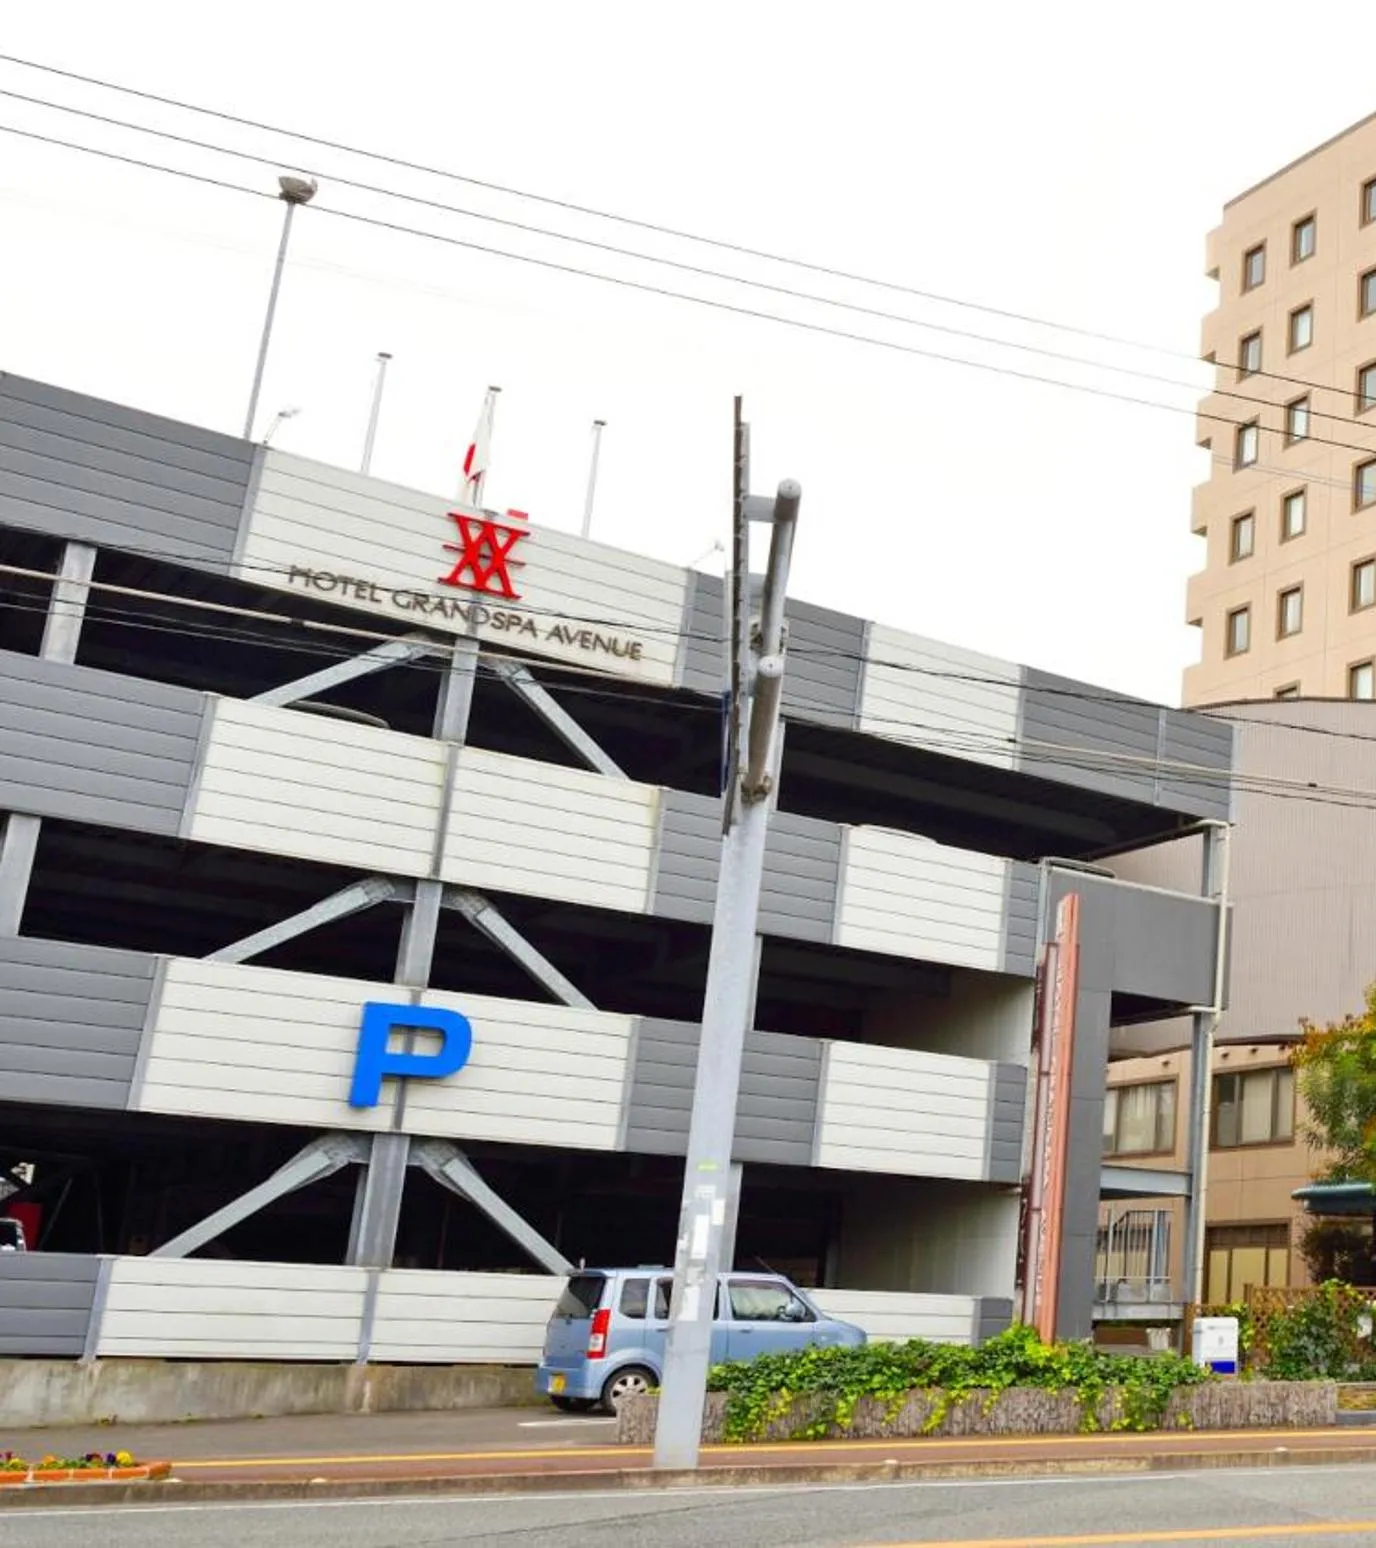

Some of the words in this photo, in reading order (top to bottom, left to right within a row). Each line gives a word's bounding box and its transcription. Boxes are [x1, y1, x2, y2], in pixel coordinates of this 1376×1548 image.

[288, 564, 383, 604] HOTEL
[391, 589, 538, 639] GRANDSPA
[545, 623, 643, 661] AVENUE
[349, 1001, 472, 1108] P
